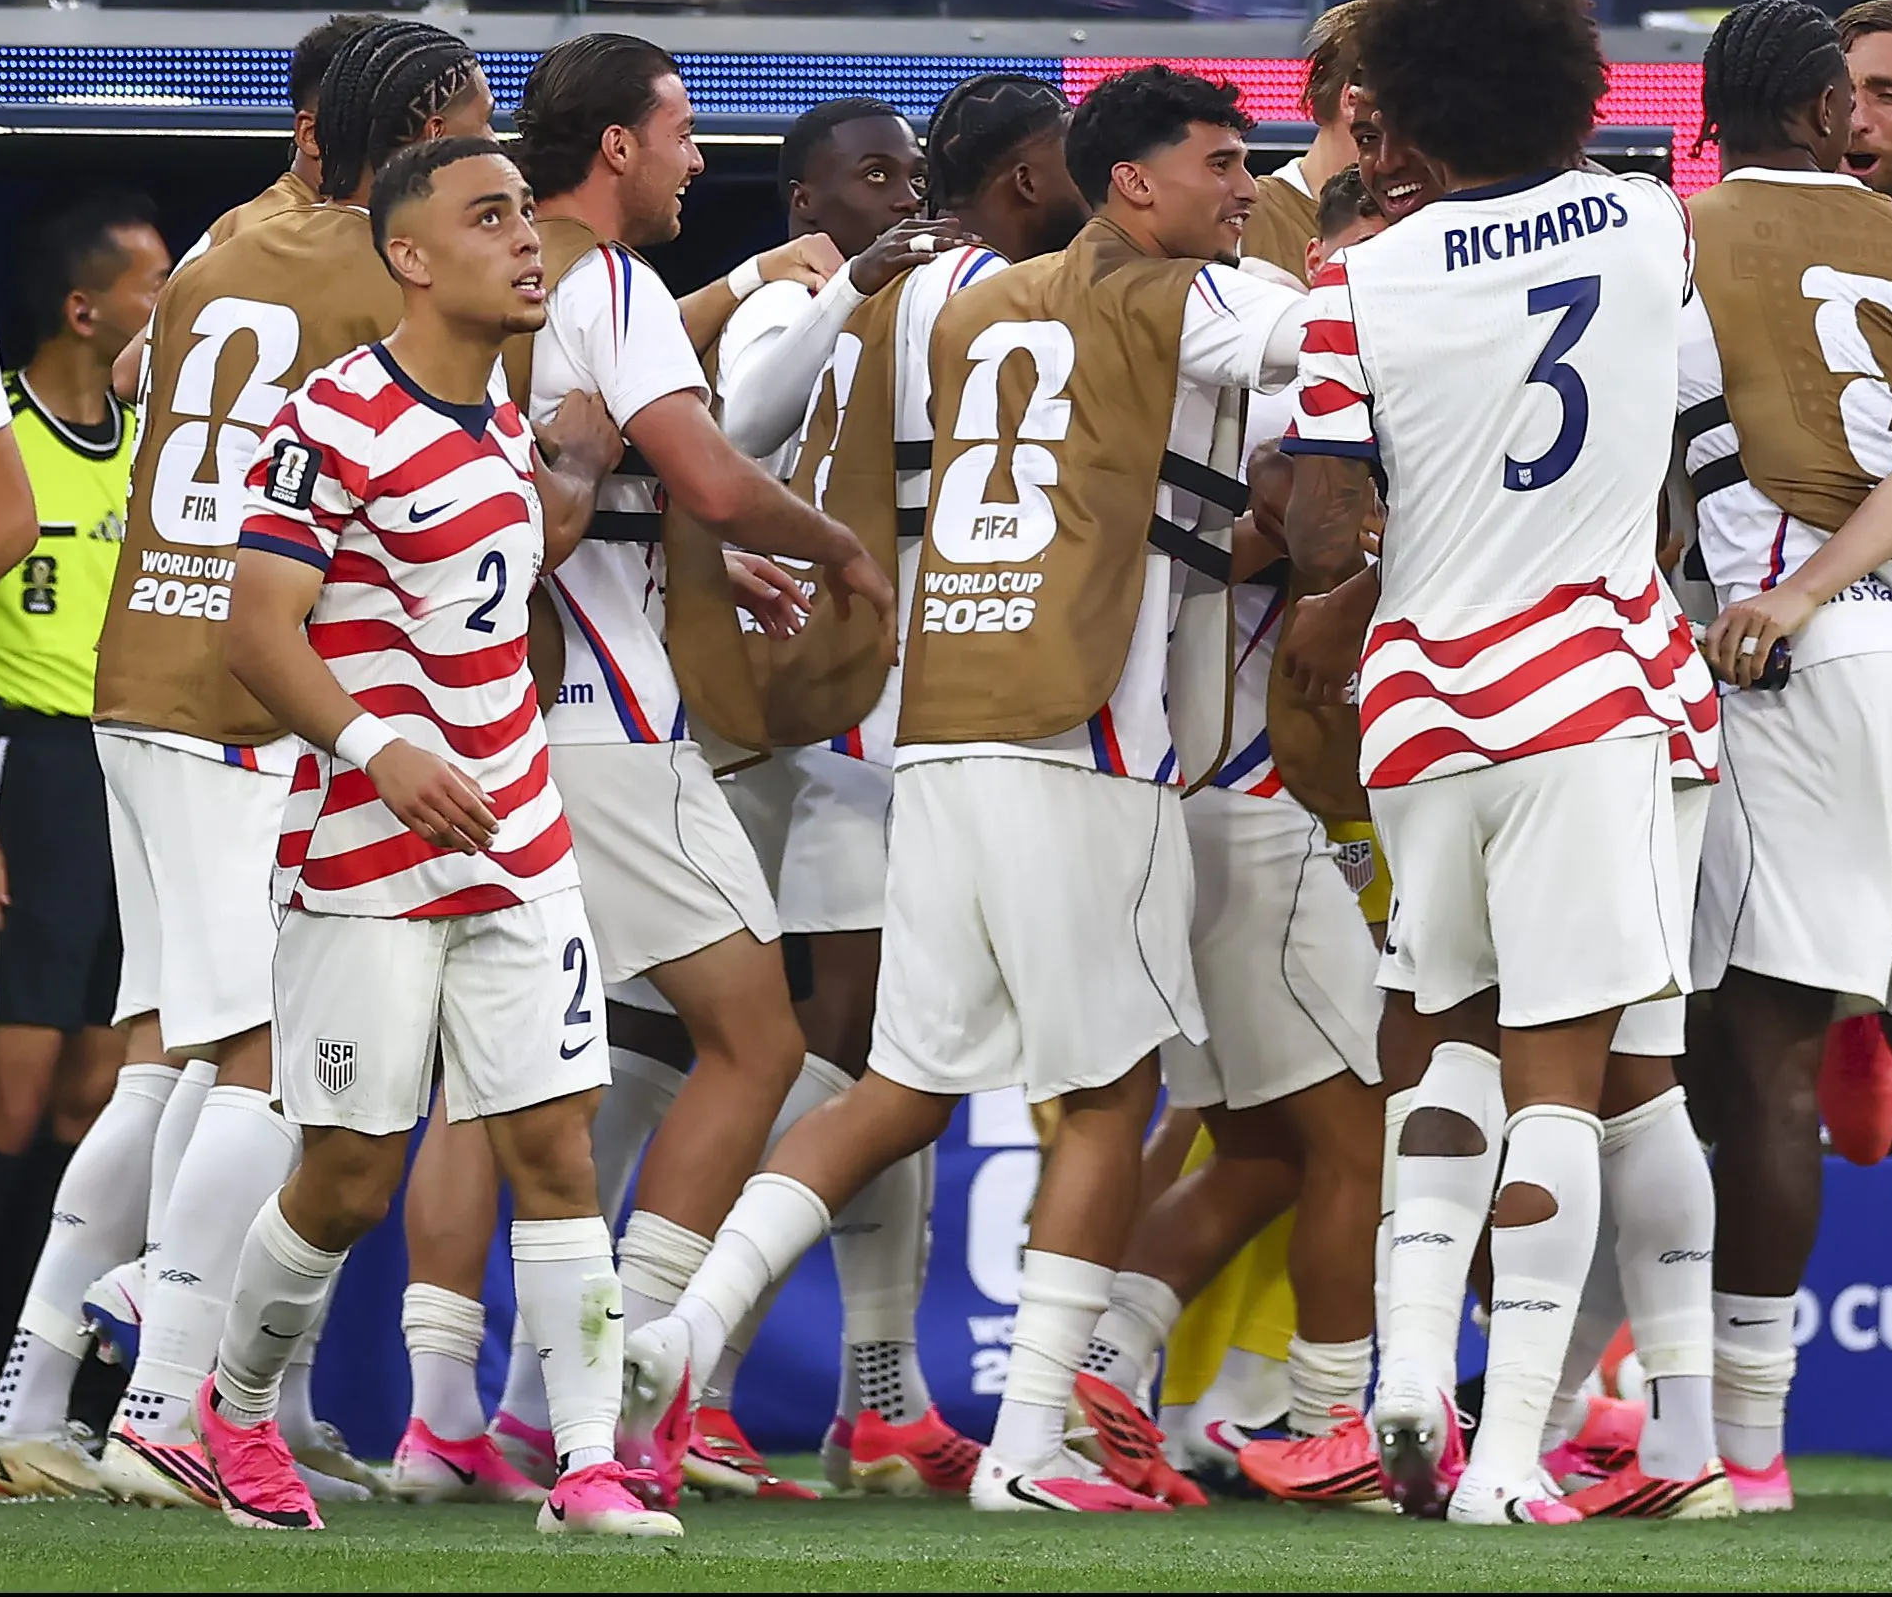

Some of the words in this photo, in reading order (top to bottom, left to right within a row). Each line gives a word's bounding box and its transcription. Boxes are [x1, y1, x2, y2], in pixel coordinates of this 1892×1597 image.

[1441, 192, 1629, 273] RICHARDS
[1502, 273, 1602, 492] 3
[181, 494, 217, 522] FIFA
[970, 515, 1018, 541] FIFA
[140, 549, 204, 579] WORLD
[127, 577, 232, 621] 2026
[464, 550, 508, 634] 2
[923, 571, 998, 595] WORLD
[998, 570, 1043, 595] CUP
[922, 597, 1036, 634] 2026
[555, 683, 594, 705] am
[562, 936, 592, 1027] 2
[318, 1042, 354, 1065] USA
